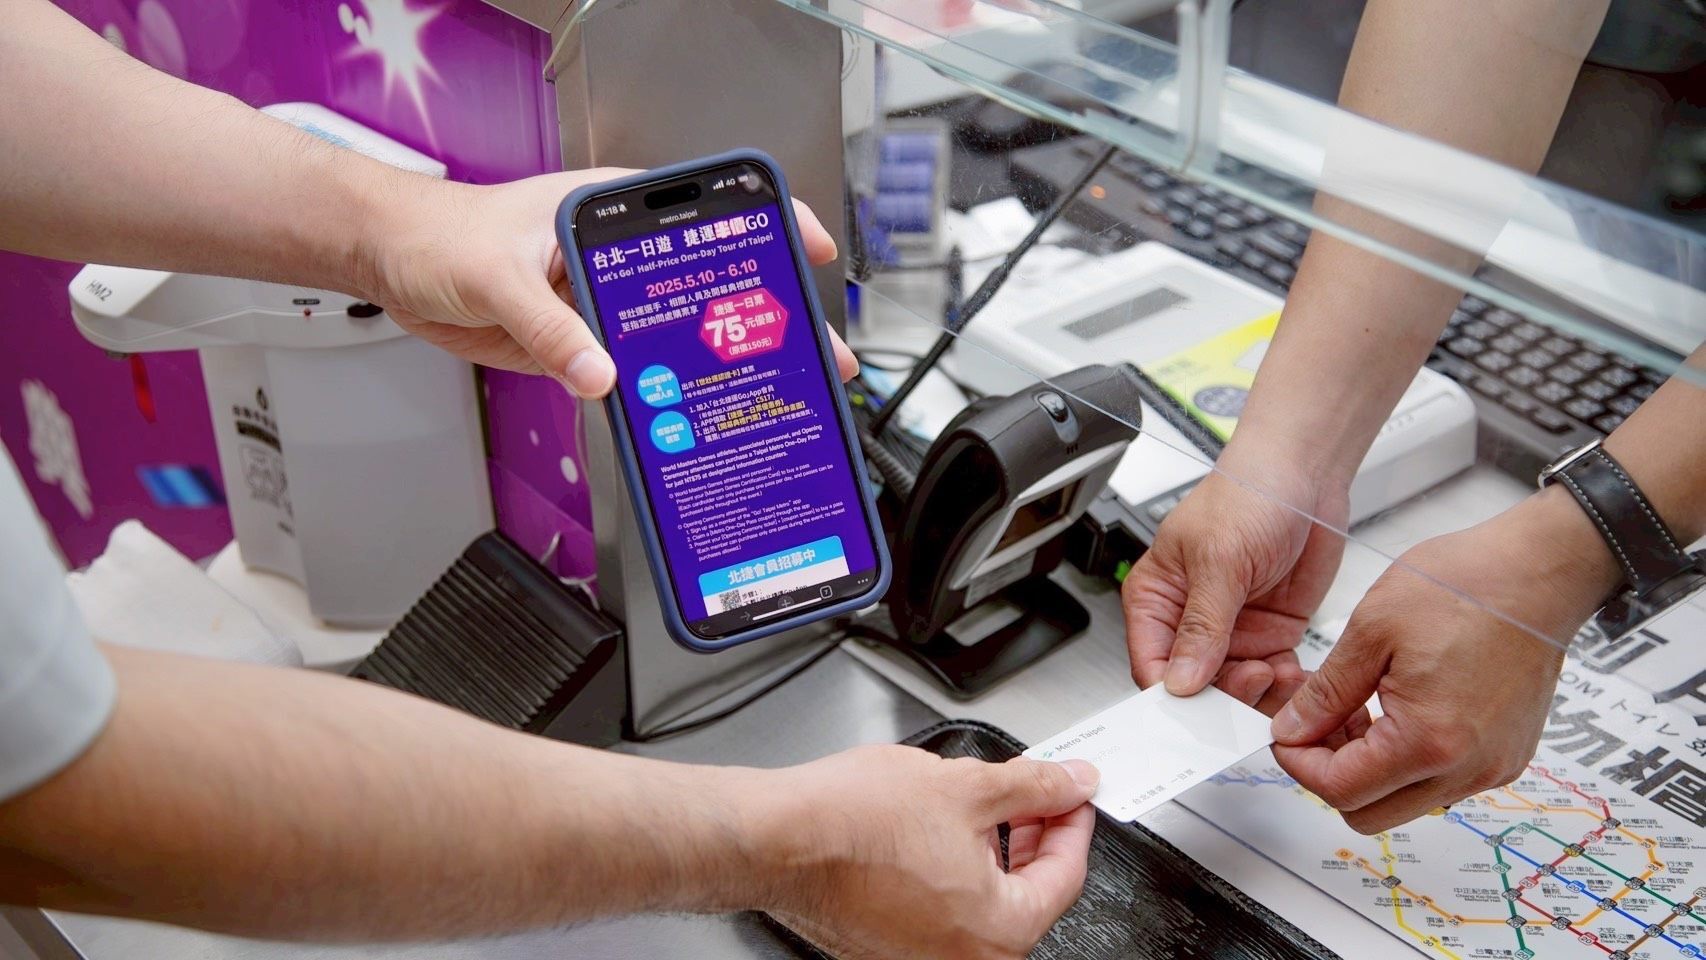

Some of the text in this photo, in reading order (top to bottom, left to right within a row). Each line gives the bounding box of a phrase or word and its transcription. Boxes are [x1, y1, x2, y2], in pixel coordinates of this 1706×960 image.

[725, 178, 735, 186] 4G
[595, 206, 618, 217] 14:18
[659, 209, 698, 225] metro.taipei
[591, 212, 770, 269] 台北一日遊 捷運半價GO
[597, 232, 773, 282] Let's Go! Half-Price One-Day Tour of Taipei
[86, 280, 112, 301] HM2
[645, 270, 715, 297] 2025.5.10
[727, 259, 758, 277] 6.10
[621, 304, 699, 332] 至指定詢問處購票享
[713, 294, 765, 316] 捷運一日票
[705, 315, 748, 347] 75
[727, 548, 816, 584] 北捷會員招募中
[1055, 724, 1106, 752] Metro Taipei
